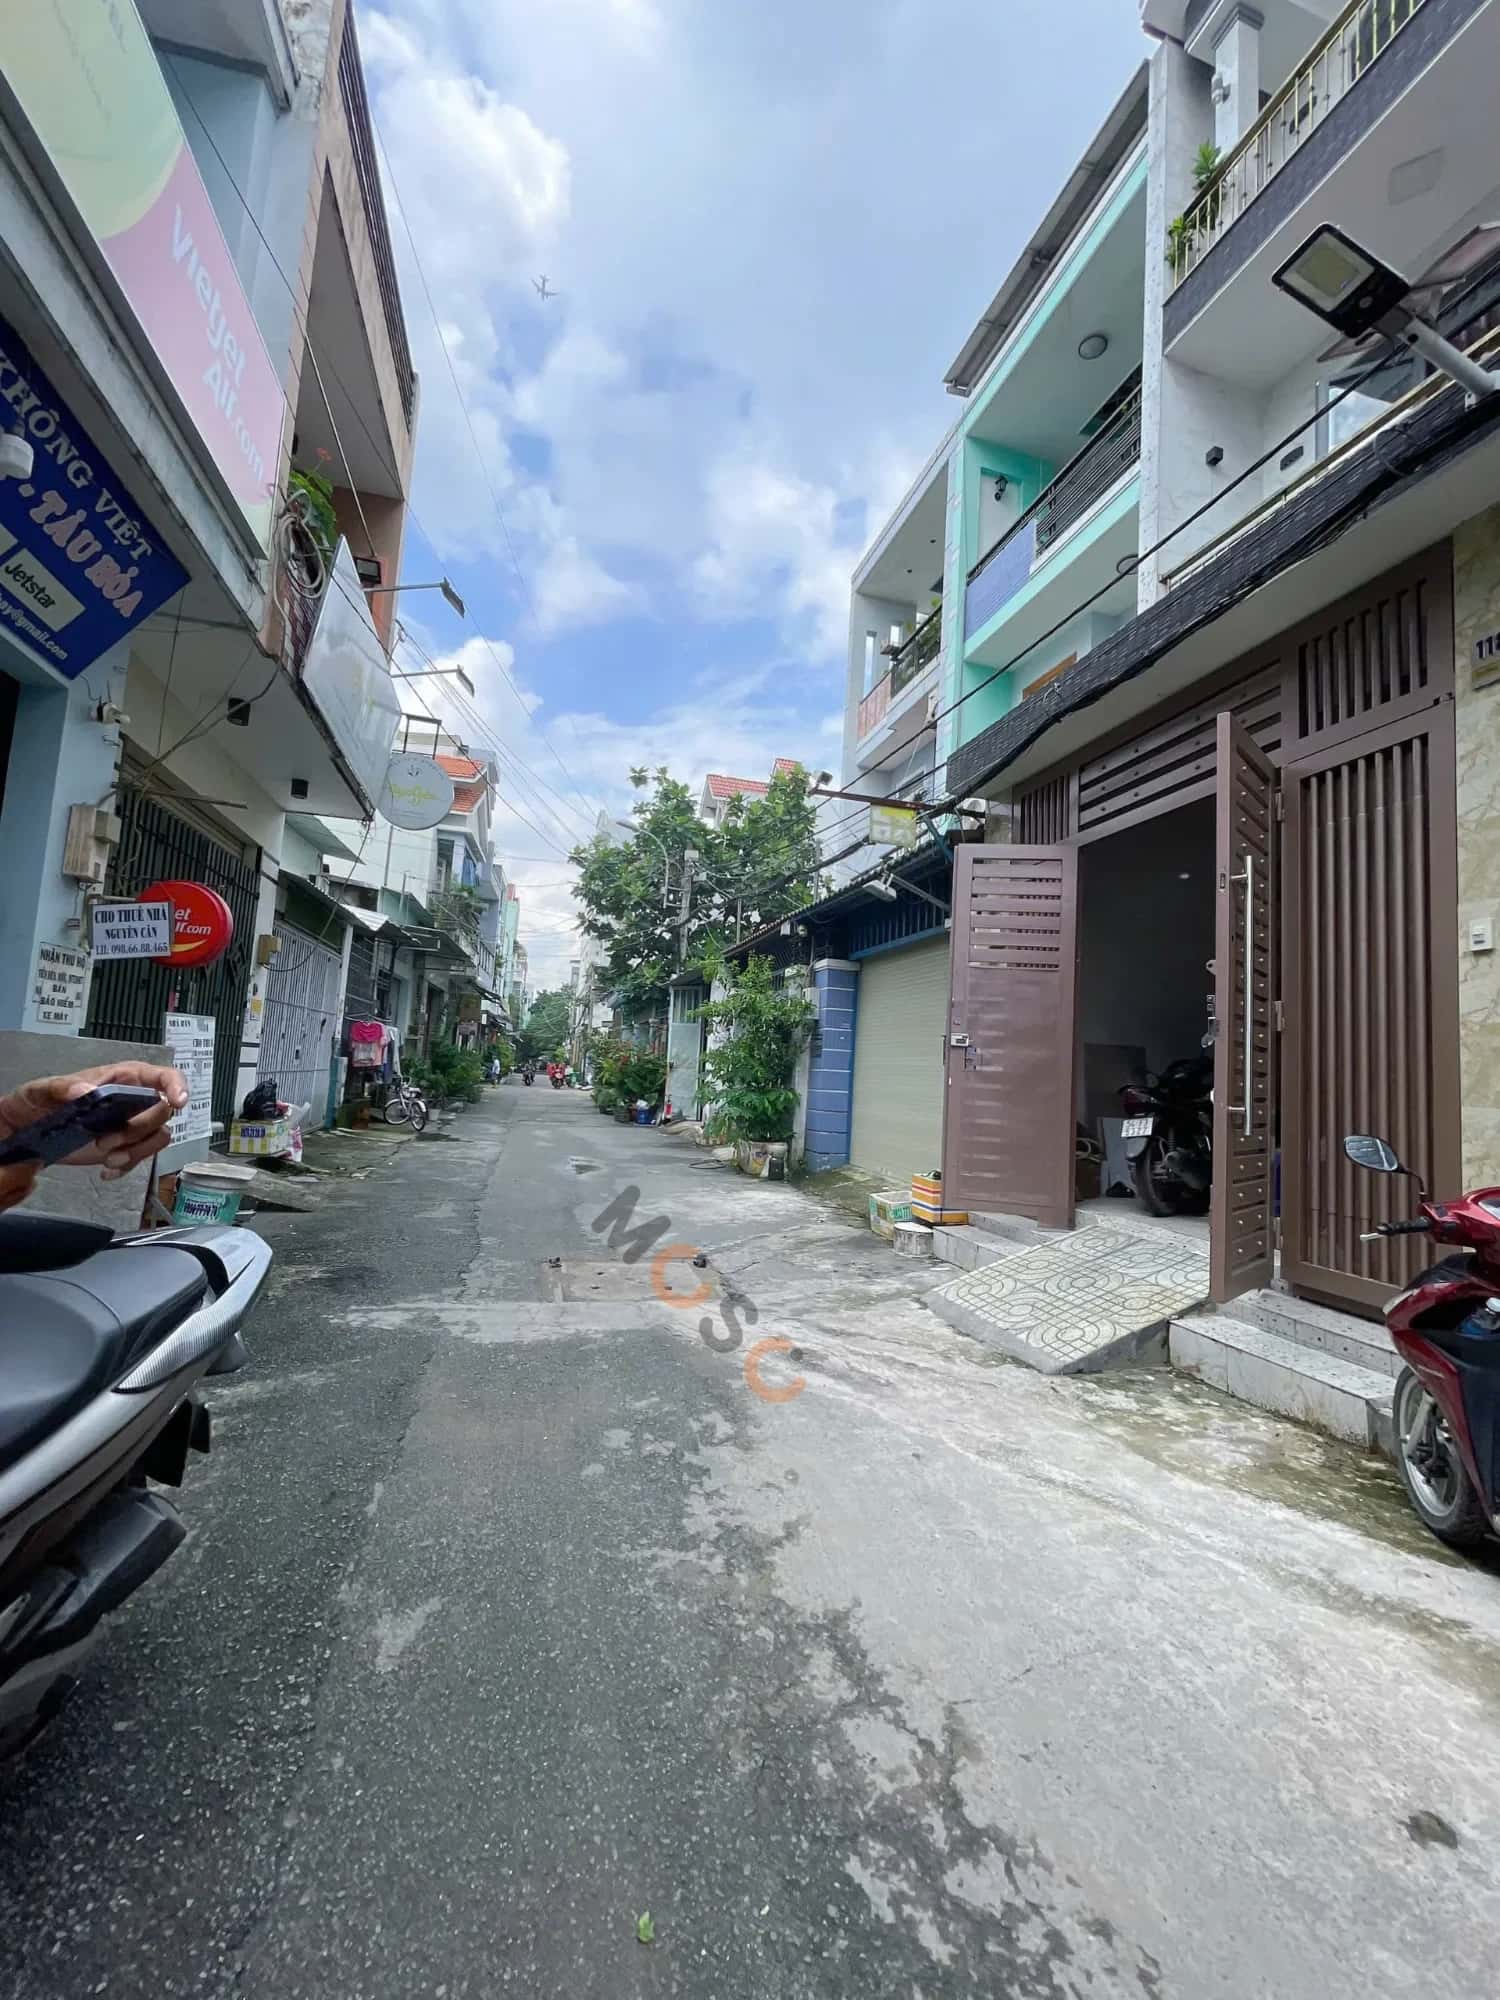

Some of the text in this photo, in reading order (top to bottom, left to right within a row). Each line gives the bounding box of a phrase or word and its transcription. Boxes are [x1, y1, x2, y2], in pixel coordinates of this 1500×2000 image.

[29, 490, 103, 563] TÀU
[94, 487, 152, 561] VIỆT
[4, 563, 56, 609] Jetstar
[95, 910, 115, 924] CHO
